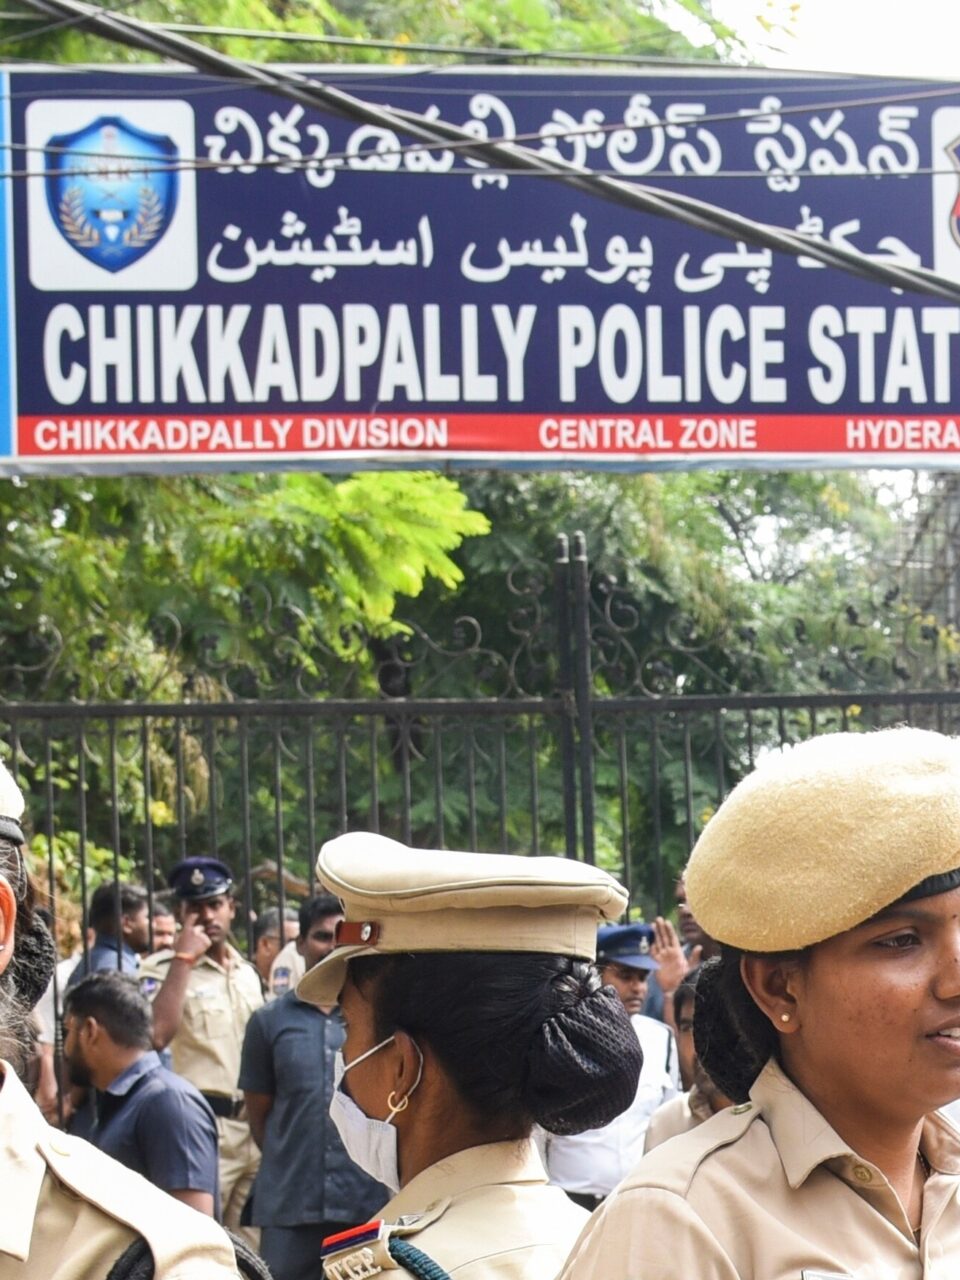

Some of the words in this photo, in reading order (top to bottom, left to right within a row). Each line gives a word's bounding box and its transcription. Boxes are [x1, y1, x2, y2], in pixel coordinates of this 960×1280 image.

[739, 96, 920, 193] స్టేషన్
[207, 206, 434, 283] اسٹیشن
[461, 213, 654, 294] پولیس
[43, 303, 537, 405] CHIKKADPALLY
[559, 303, 787, 404] POLICE
[34, 418, 292, 451] CHIKKADPALLY
[303, 418, 448, 448] DIVISION
[538, 418, 672, 450] CENTRAL
[680, 418, 757, 449] ZONE
